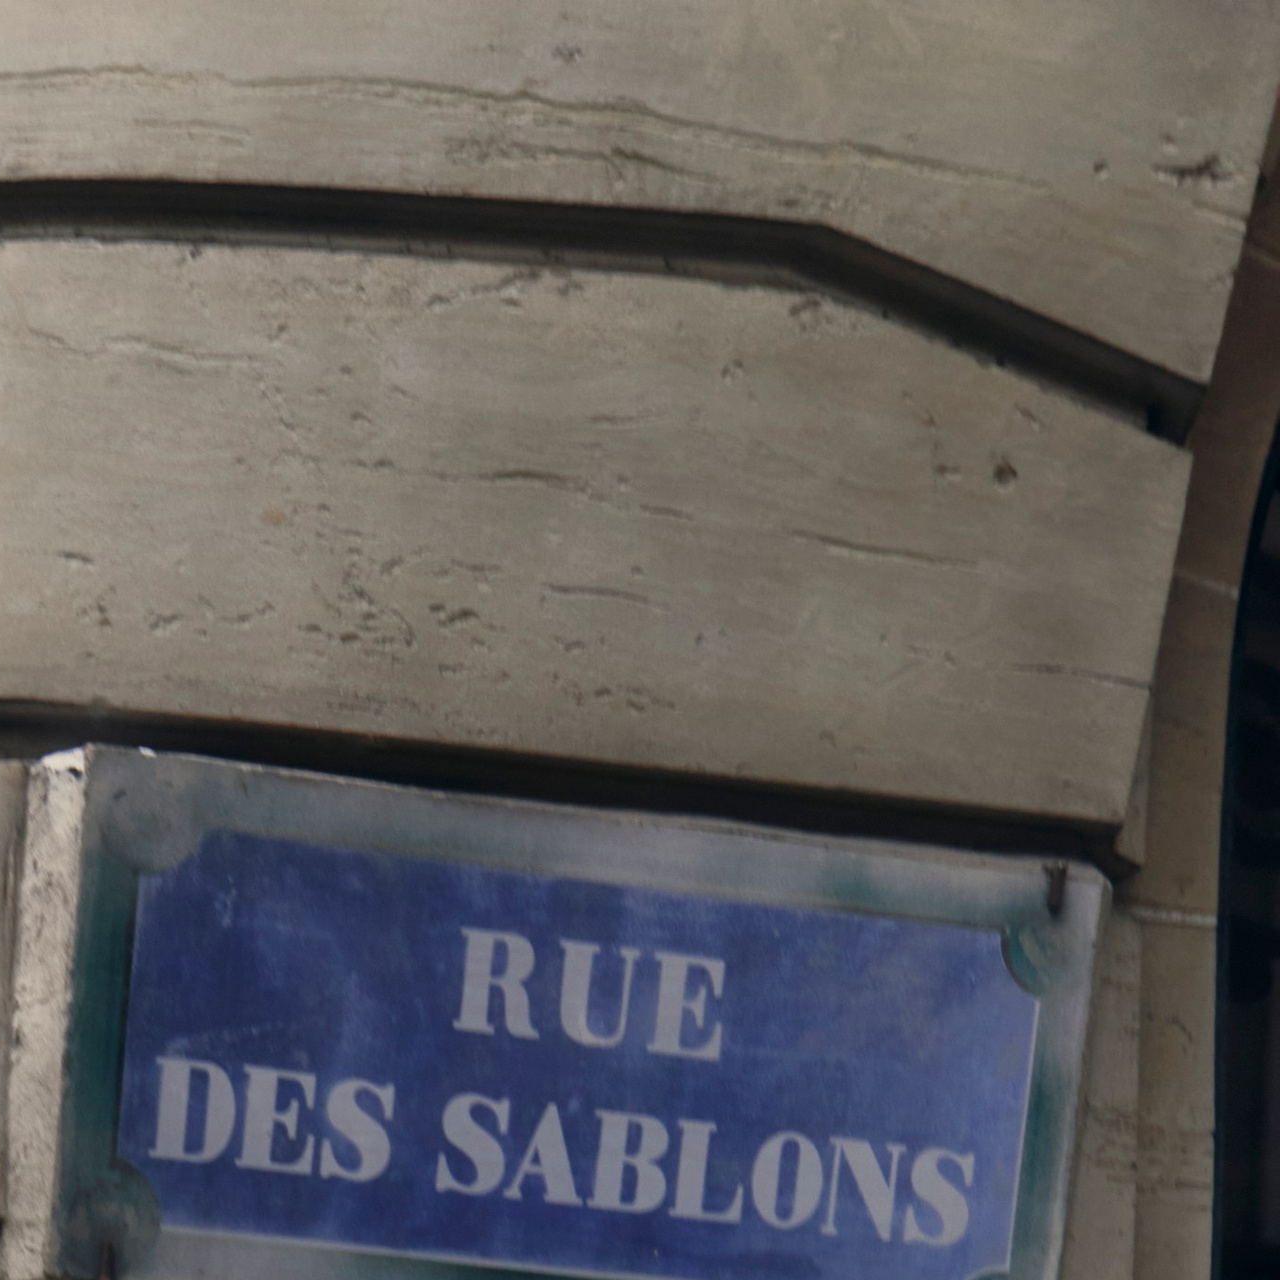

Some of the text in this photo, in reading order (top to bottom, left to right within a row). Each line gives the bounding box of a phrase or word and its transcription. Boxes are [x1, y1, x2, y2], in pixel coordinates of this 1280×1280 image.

[452, 927, 725, 1061] RUE
[149, 1056, 976, 1248] DES SABLONS
